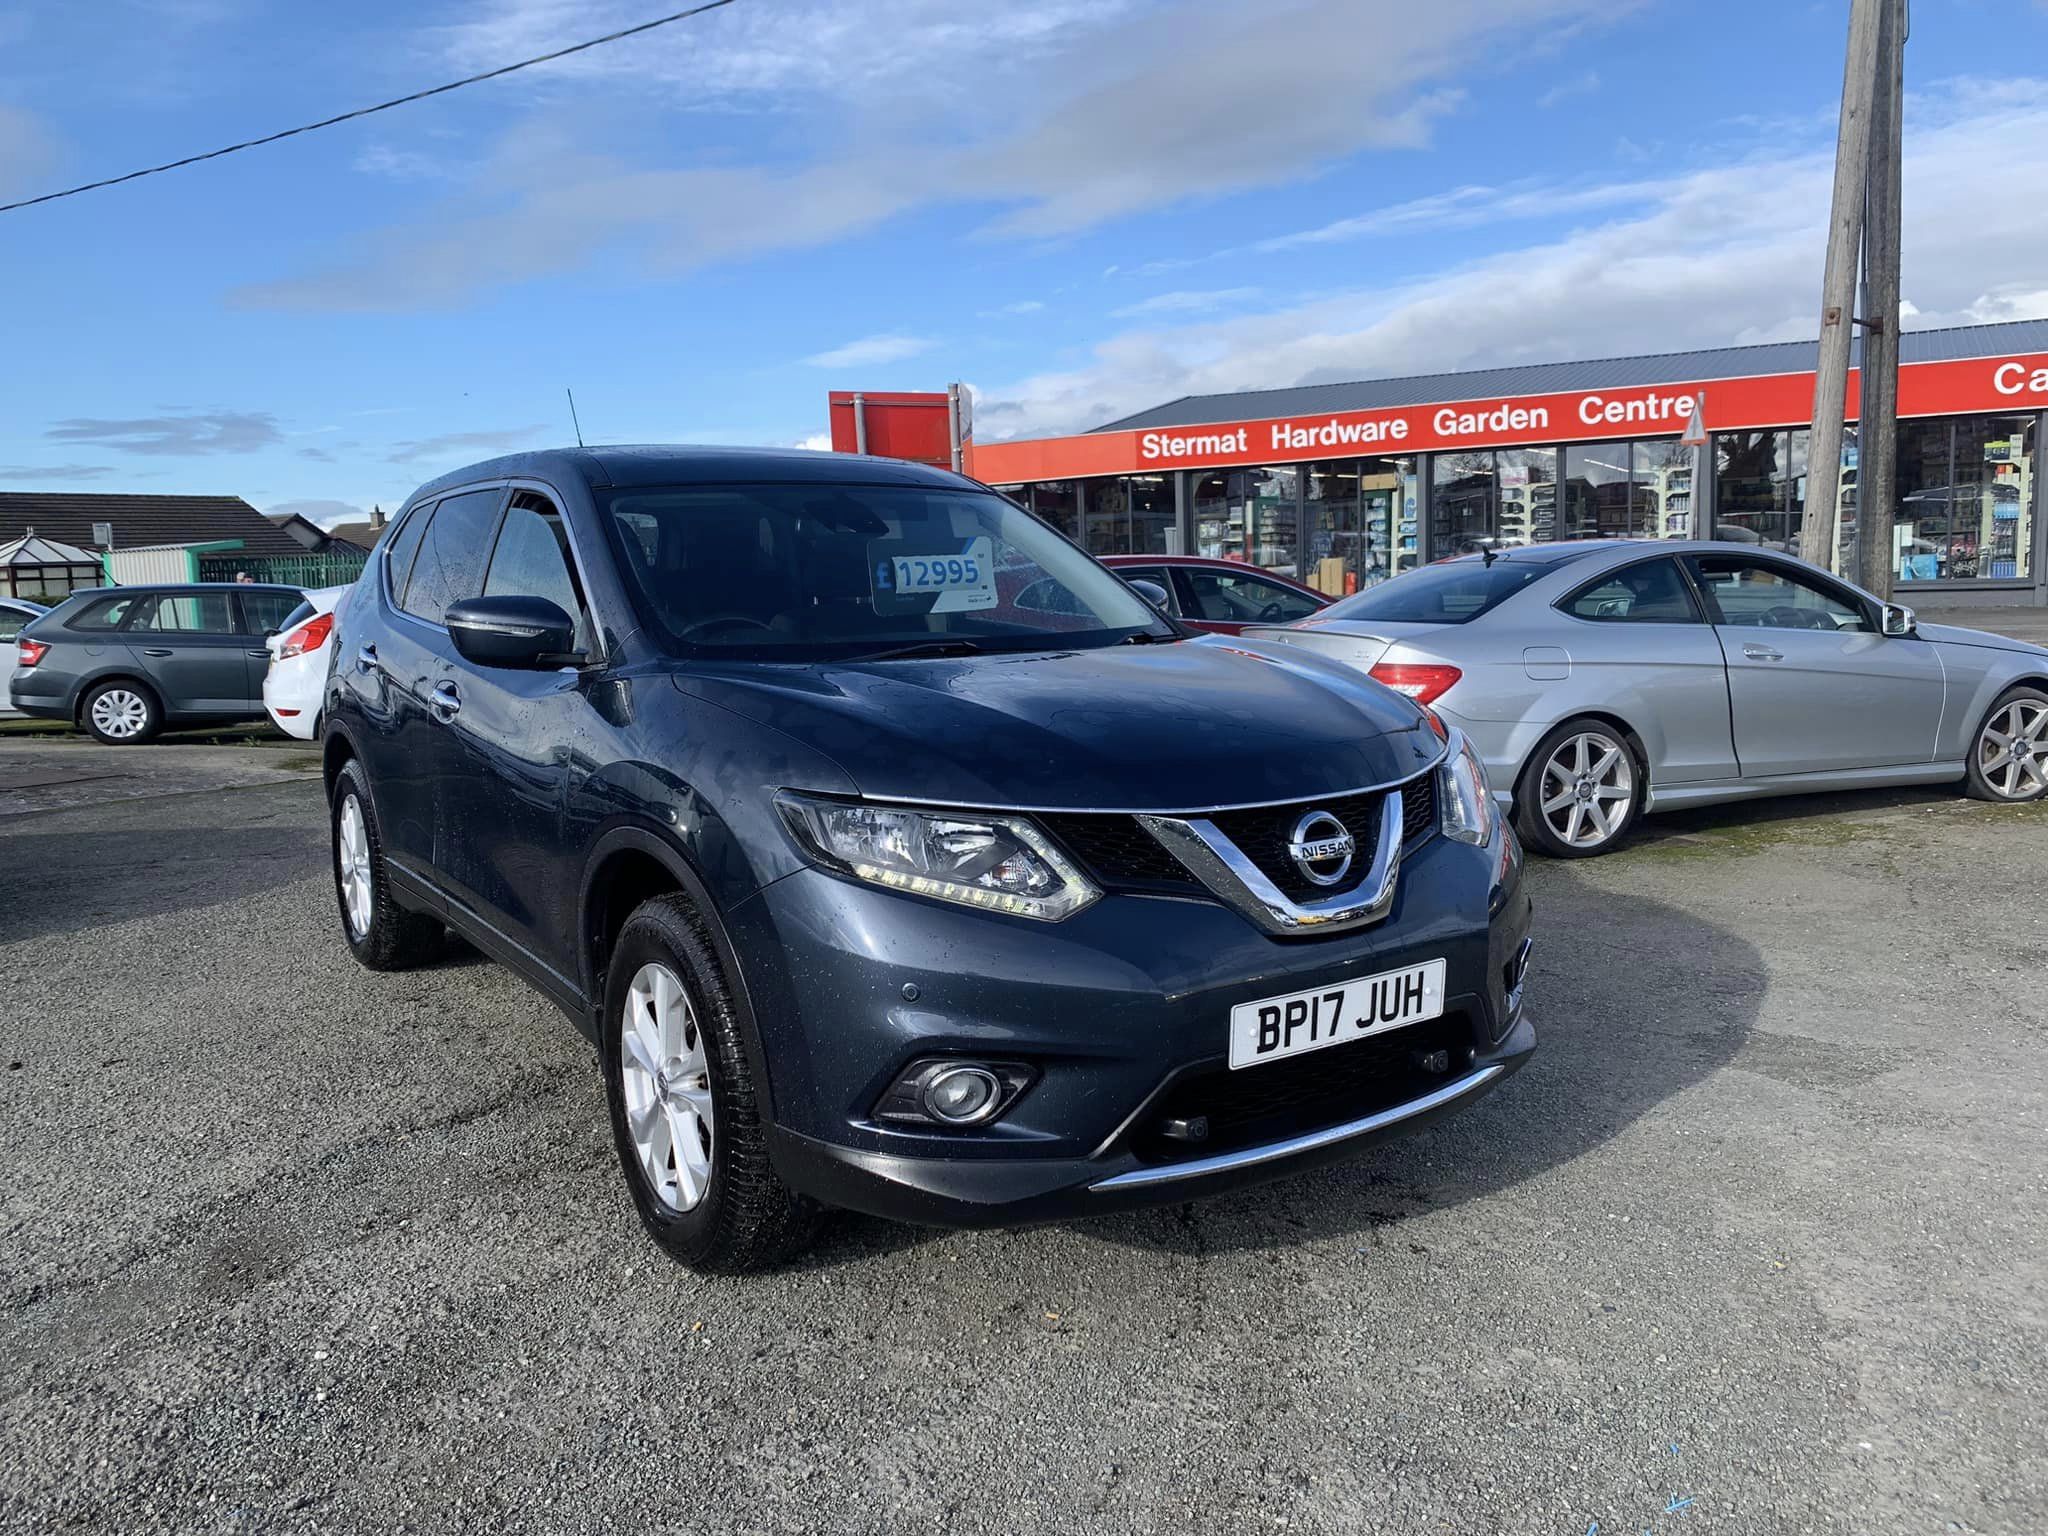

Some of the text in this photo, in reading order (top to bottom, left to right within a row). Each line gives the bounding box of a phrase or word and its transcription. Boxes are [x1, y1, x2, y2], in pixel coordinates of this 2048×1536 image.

[1142, 393, 1695, 459] Stermat Hardware Garden Centre
[1301, 839, 1352, 858] NISSAN
[1256, 970, 1425, 1055] BP17 JUH
